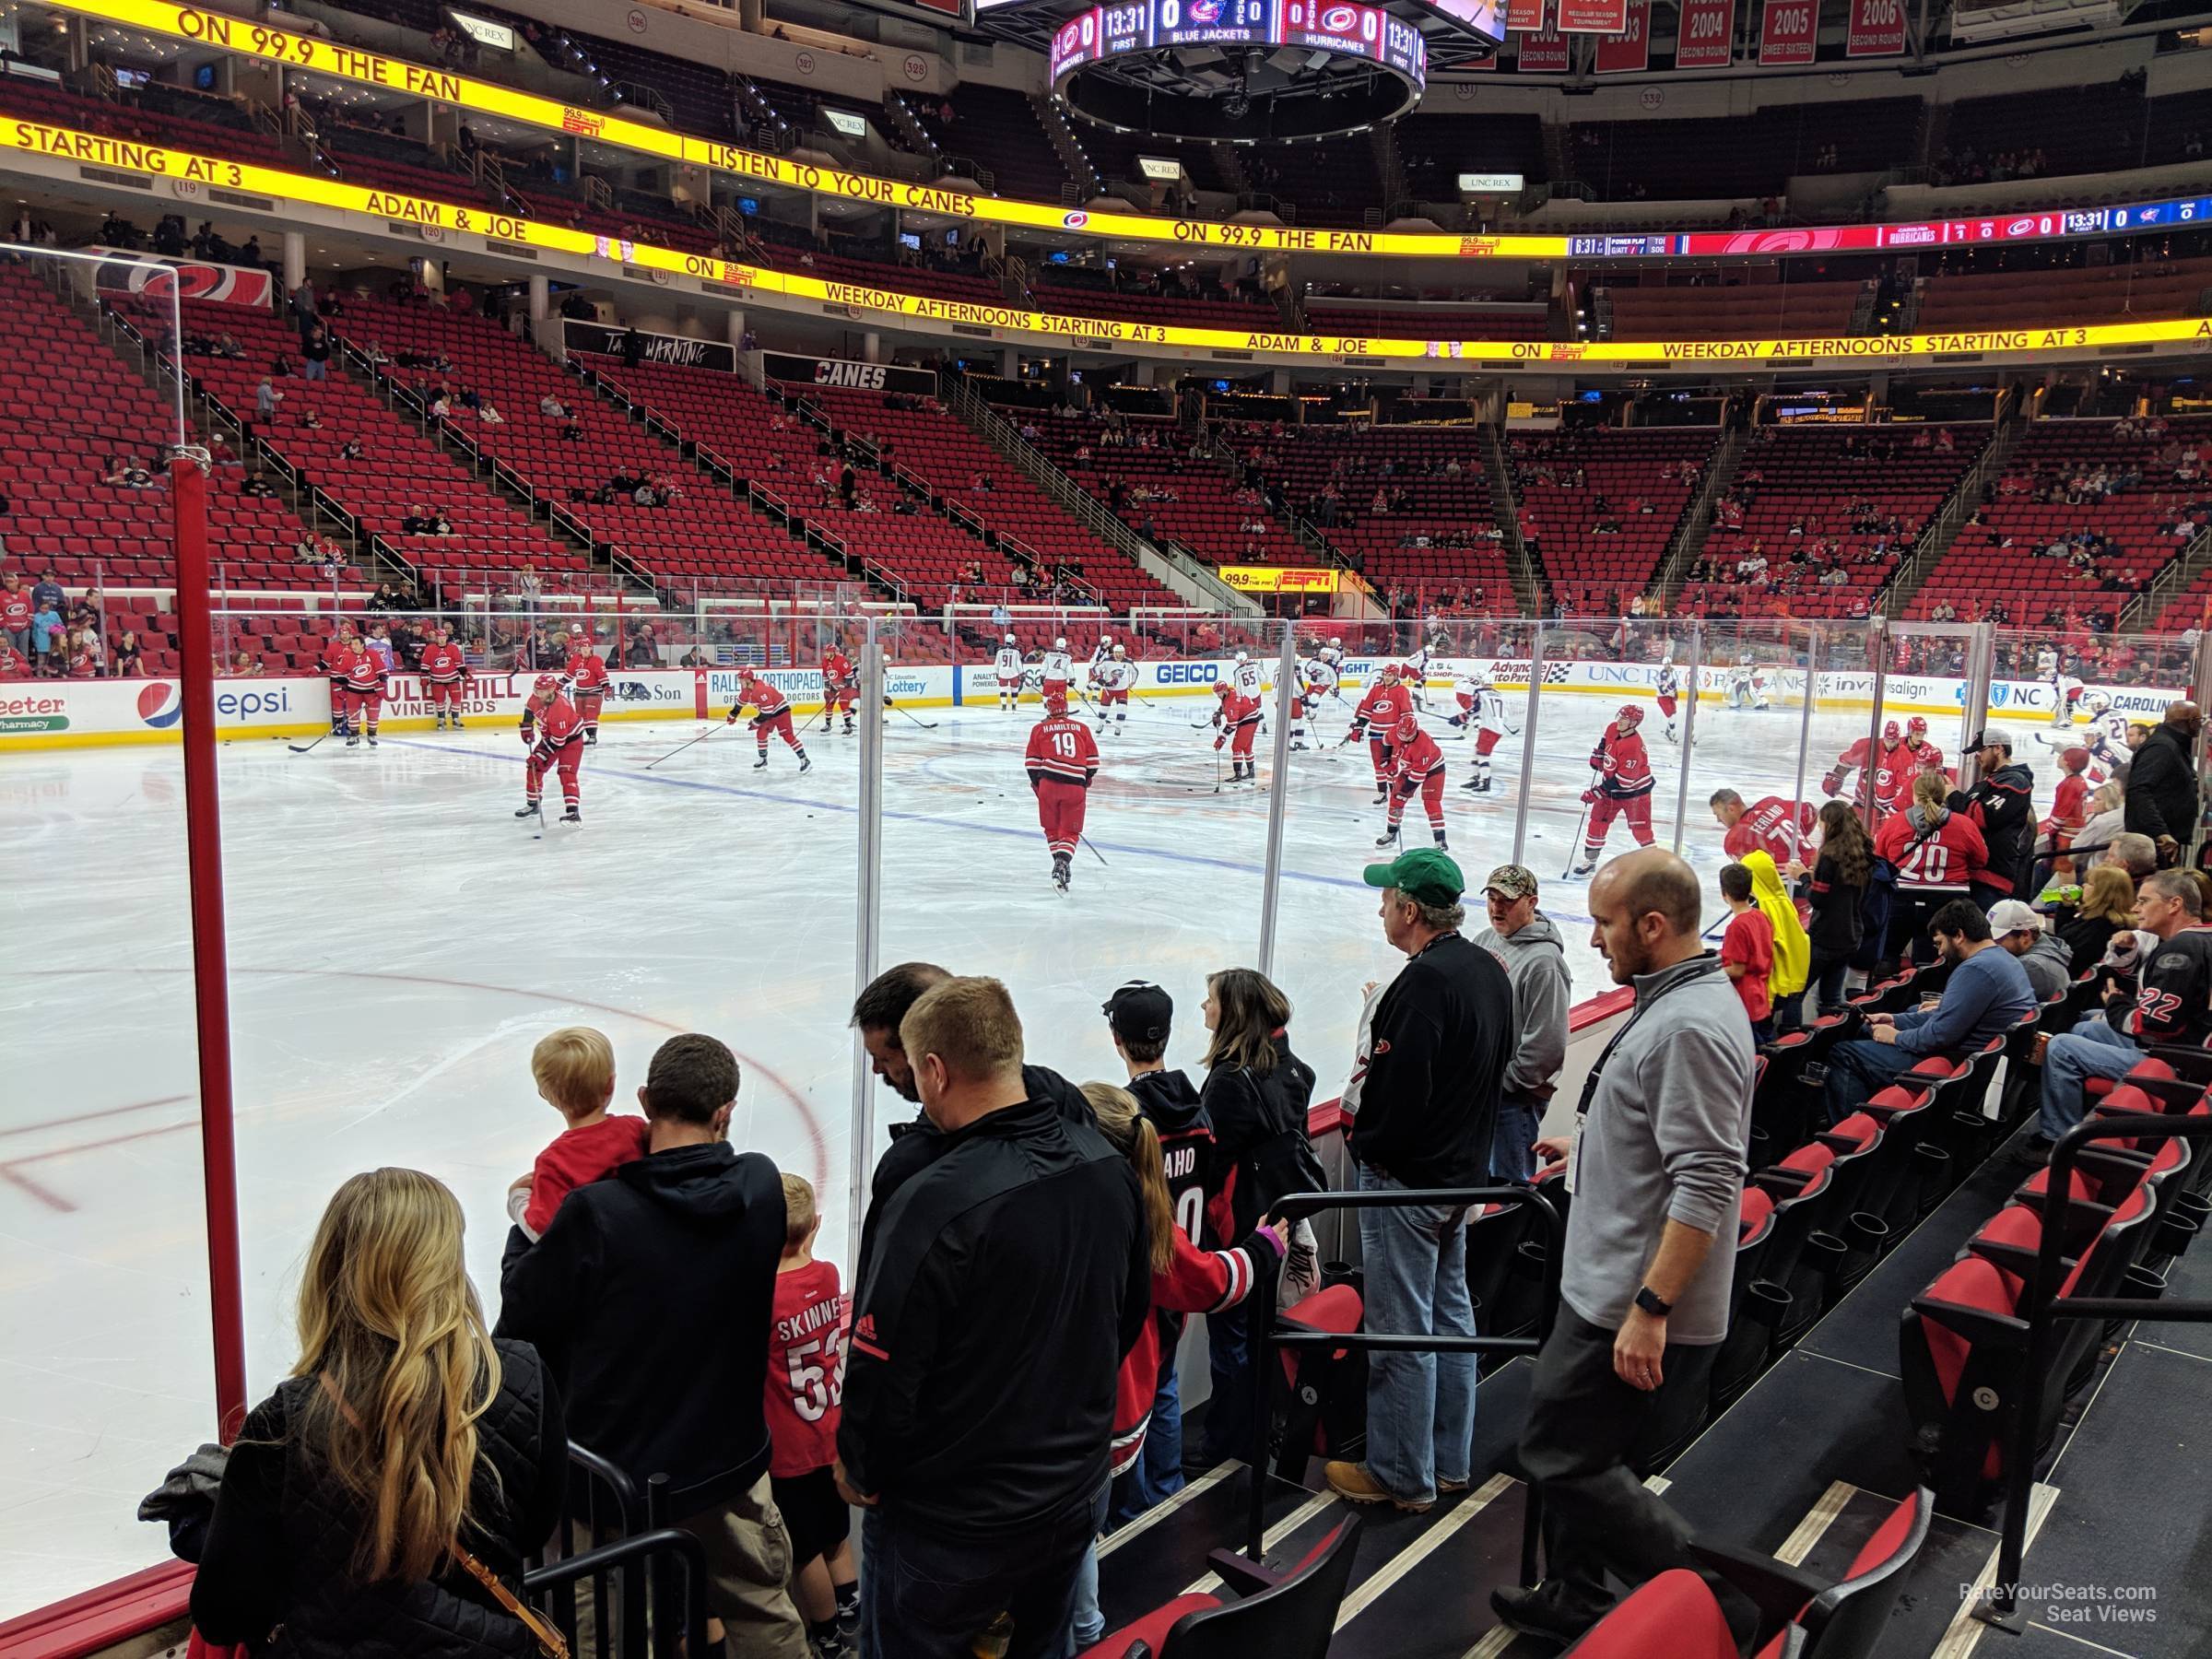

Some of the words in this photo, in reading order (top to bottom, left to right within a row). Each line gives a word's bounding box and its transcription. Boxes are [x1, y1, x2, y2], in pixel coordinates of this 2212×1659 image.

[1250, 2, 1262, 20] 0
[1291, 5, 1301, 23] 0
[1107, 6, 1145, 37] 13:31
[1363, 11, 1377, 41] 0
[1690, 12, 1724, 38] 2004
[1774, 8, 1808, 35] 2005
[485, 29, 505, 41] REX
[1082, 16, 1094, 46] 0
[1172, 30, 1200, 42] BLUE
[1202, 29, 1251, 41] JACKETS
[1389, 22, 1414, 56] 13:31
[1852, 33, 1877, 45] SECOND
[1112, 37, 1136, 52] FIRST
[1306, 34, 1365, 53] HURRICANES
[1680, 47, 1705, 58] SECOND
[1706, 47, 1728, 56] ROUND
[178, 9, 229, 45] ON
[252, 28, 314, 64] 99.9
[332, 47, 388, 84] THE
[406, 66, 460, 101] FAN
[1522, 52, 1544, 62] SECOND
[1546, 52, 1566, 62] ROUND
[17, 124, 166, 173] STARTING
[184, 158, 218, 182] AT
[227, 164, 241, 186] 3
[179, 179, 196, 193] 119
[709, 145, 780, 179] LISTEN
[793, 164, 819, 188] TO
[833, 173, 893, 201] YOUR
[906, 185, 974, 216] CANES
[366, 192, 440, 224] ADAM
[455, 209, 471, 230] &
[485, 216, 526, 241] JOE
[2068, 212, 2101, 228] 13:31
[2115, 210, 2127, 227] 0
[2181, 209, 2193, 219] 0
[424, 225, 440, 237] 120
[1982, 228, 1993, 238] 0
[2041, 218, 2052, 234] 0
[1173, 220, 1207, 241] ON
[1220, 224, 1261, 245] 99.9
[1276, 229, 1315, 249] THE
[1329, 232, 1372, 251] FAN
[1889, 230, 1936, 244] HURRICANES
[1576, 239, 1595, 254] 6:31
[686, 256, 714, 276] ON
[825, 283, 906, 312] WEEKDAY
[916, 299, 1030, 329] AFTERNOONS
[1041, 316, 1122, 338] STARTING
[1132, 325, 1151, 340] AT
[1156, 327, 1166, 341] 3
[645, 335, 708, 366] WARNING
[1247, 334, 1300, 350] ADAM
[1311, 337, 1324, 351] &
[1334, 337, 1368, 354] JOE
[1512, 344, 1541, 358] ON
[1663, 342, 1760, 358] WEEKDAY
[1772, 338, 1912, 357] AFTERNOONS
[1925, 333, 2028, 351] STARTING
[2042, 330, 2068, 347] AT
[2074, 329, 2087, 344] 3
[814, 360, 886, 389] CANES
[1225, 573, 1249, 585] 99.9
[1281, 571, 1330, 586] ESPN
[1002, 655, 1013, 667] 91
[1053, 659, 1062, 669] 4
[1156, 664, 1218, 684] GEICO
[1241, 671, 1255, 687] 65
[1588, 665, 1640, 684] UNC
[622, 682, 632, 696] &
[654, 684, 681, 700] Son
[887, 680, 928, 694] Lottery
[218, 687, 289, 721] epsi
[786, 693, 820, 701] DOCTORS
[2013, 688, 2041, 705] NC
[0, 697, 65, 715] eeter
[1489, 699, 1503, 718] 17
[0, 721, 49, 729] harmacy
[559, 721, 566, 729] 11
[1043, 724, 1081, 733] HAMILTON
[1052, 733, 1077, 758] 19
[1626, 759, 1637, 770] 37
[1985, 794, 2006, 810] 74
[1749, 805, 1784, 834] FERLAND
[1900, 841, 1948, 882] 20
[2138, 988, 2182, 1022] 22
[1163, 1147, 1195, 1178] AHO
[1177, 1186, 1204, 1248] 0
[778, 1296, 842, 1341] SKINNE
[1981, 1393, 1991, 1404] C
